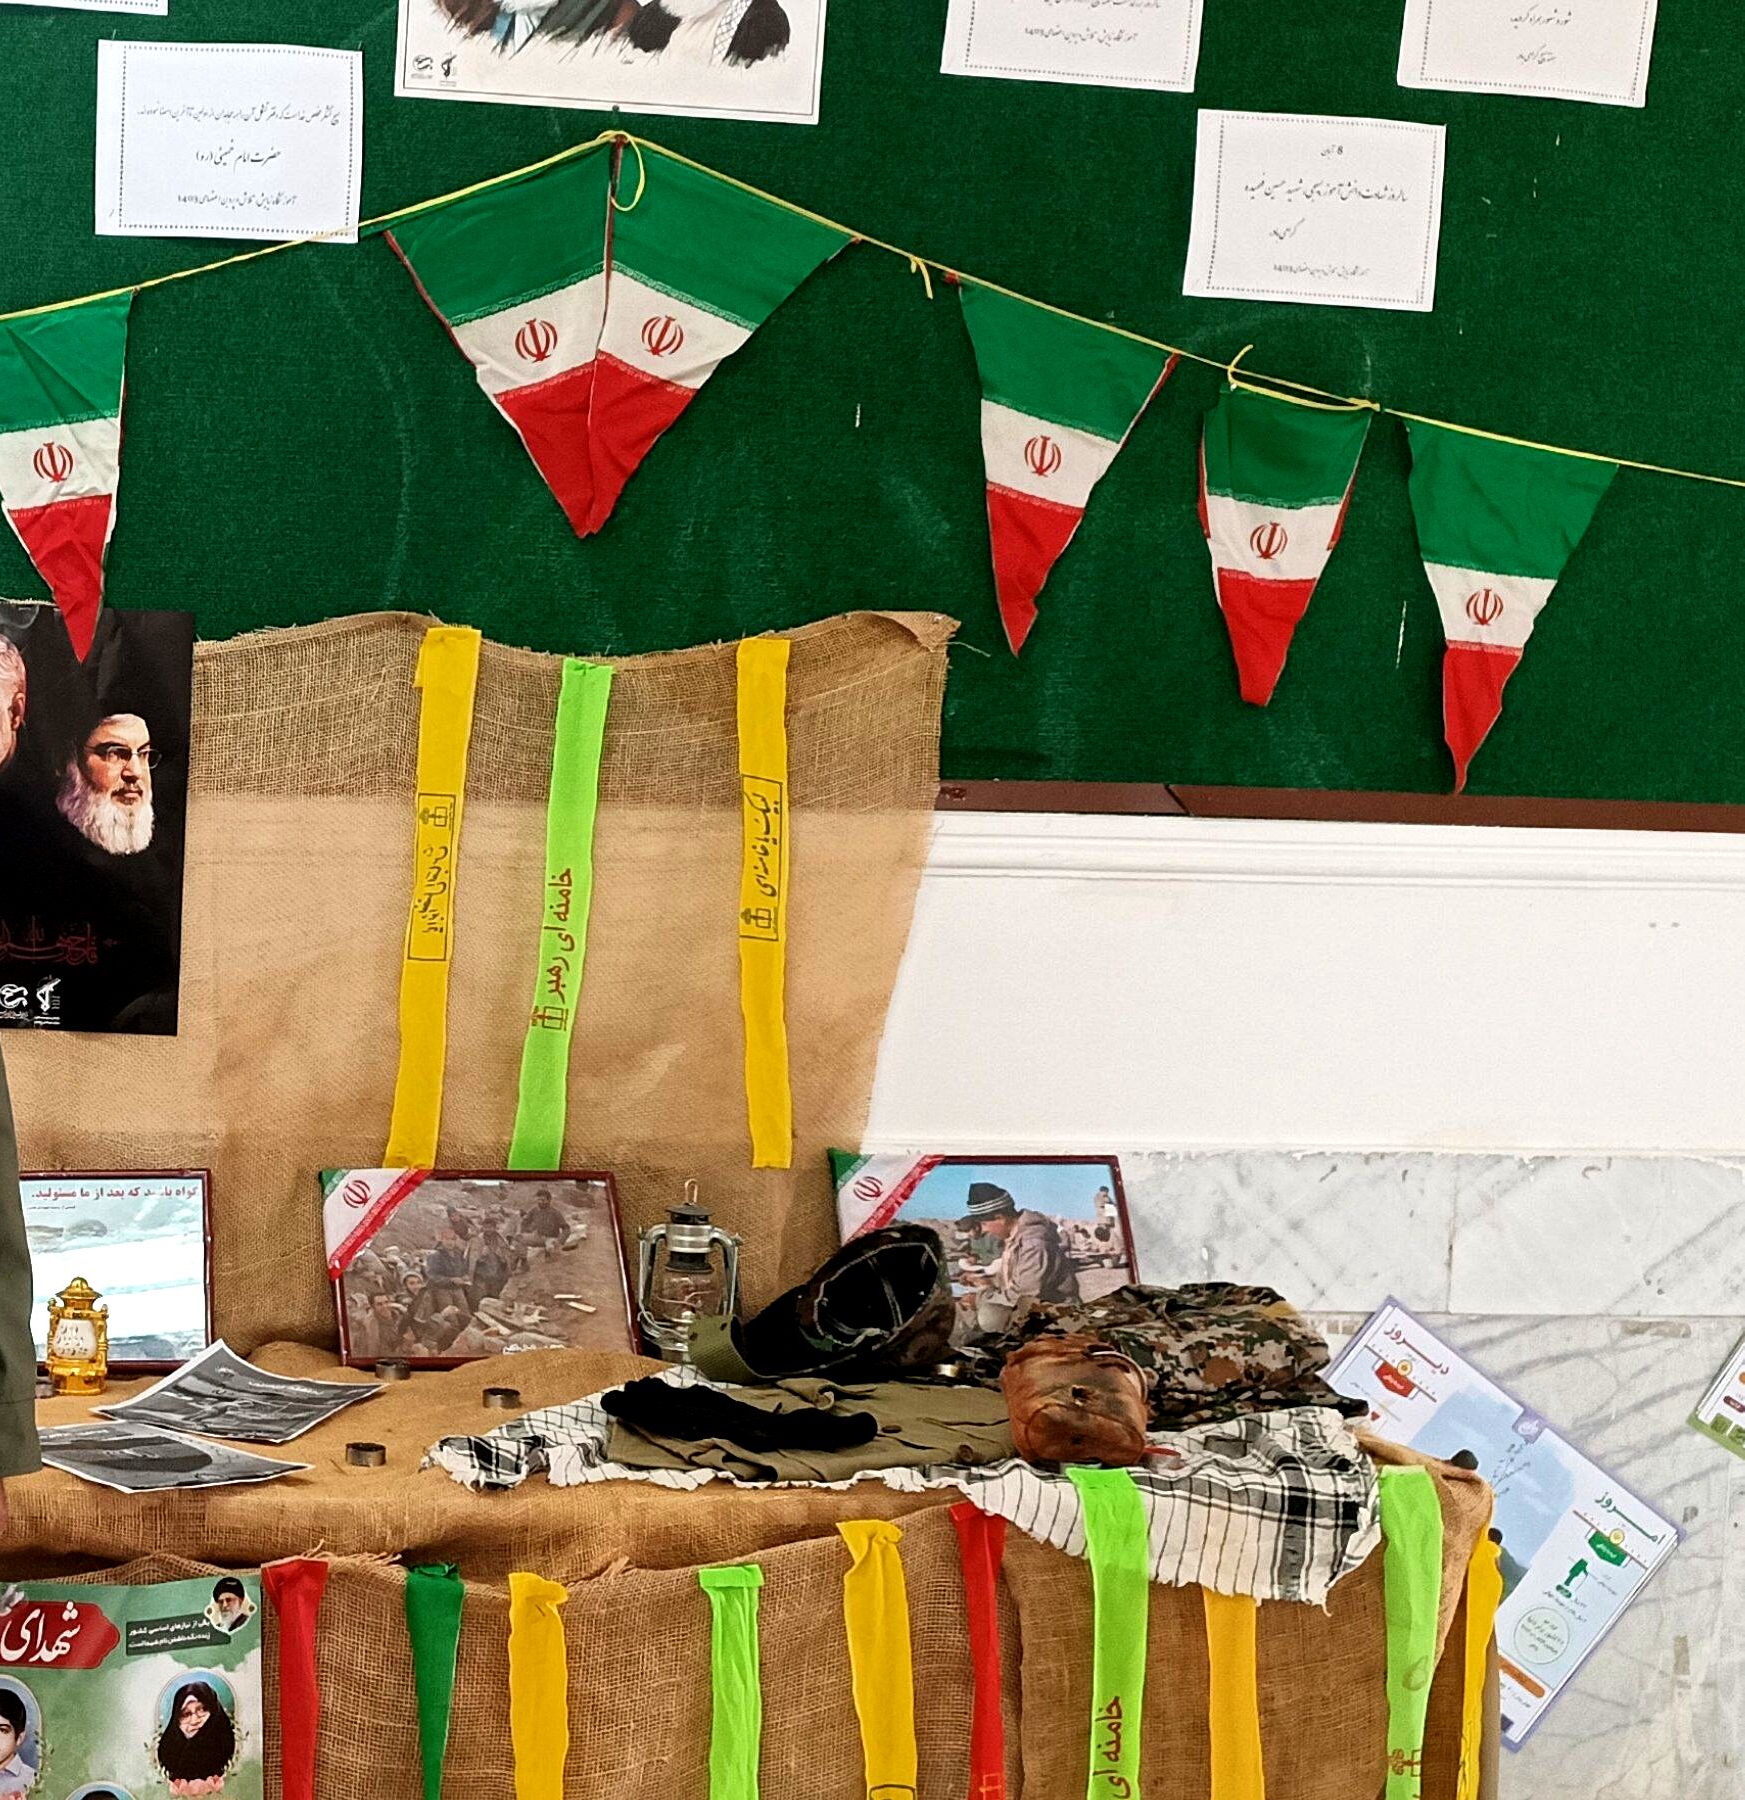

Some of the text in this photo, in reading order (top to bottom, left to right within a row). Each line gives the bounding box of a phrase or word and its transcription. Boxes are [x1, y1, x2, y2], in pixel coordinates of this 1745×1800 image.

[250, 147, 281, 167] حضرت
[743, 792, 779, 834] لبیک
[543, 867, 575, 1004] خامنه ای رهبر
[80, 1187, 90, 1198] ما
[94, 1187, 104, 1200] از
[106, 1189, 124, 1200] بعد
[127, 1186, 141, 1197] که
[1383, 1322, 1450, 1377] دیروز
[1594, 1490, 1665, 1546] امروز
[0, 1600, 82, 1664] شهدای
[1091, 1695, 1132, 1800] خامنه ای
